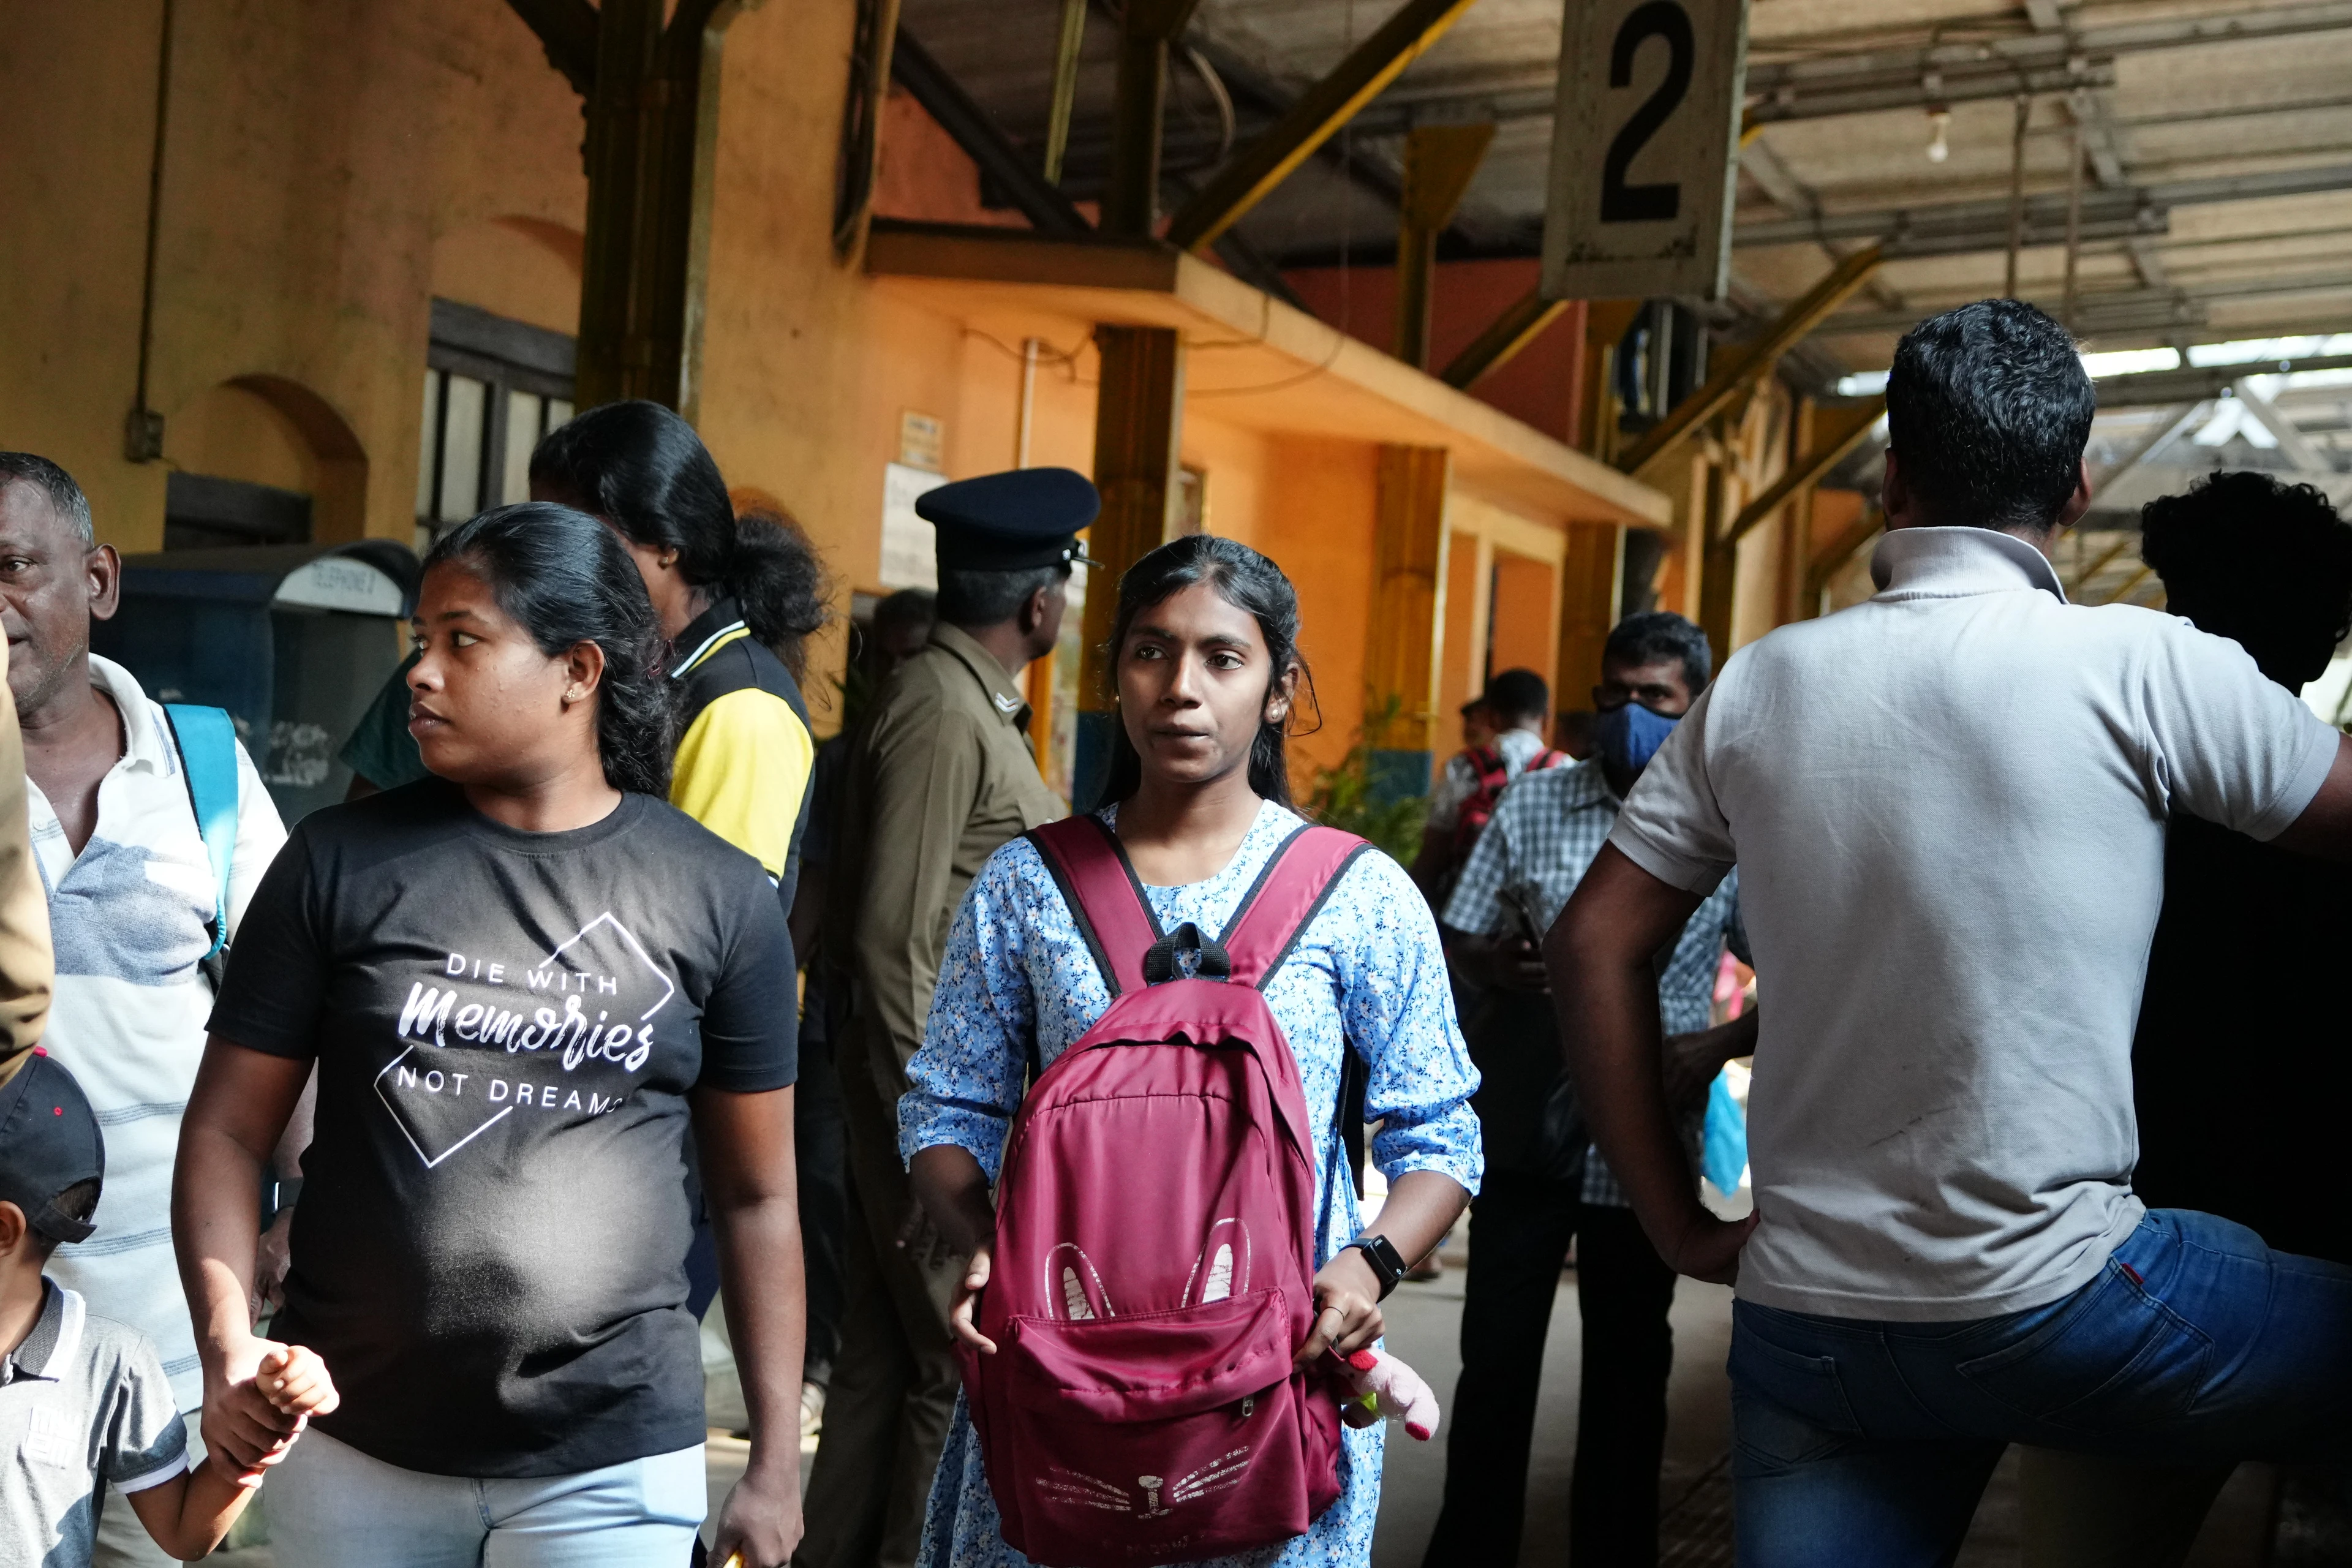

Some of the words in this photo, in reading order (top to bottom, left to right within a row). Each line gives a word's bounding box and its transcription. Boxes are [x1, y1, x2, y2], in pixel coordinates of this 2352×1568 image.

[1600, 1, 1694, 221] 2
[447, 953, 505, 982] DIE
[527, 969, 617, 995] WITH
[398, 982, 654, 1071] Memories
[398, 1066, 469, 1095] NOT
[489, 1079, 623, 1114] DREAMS
